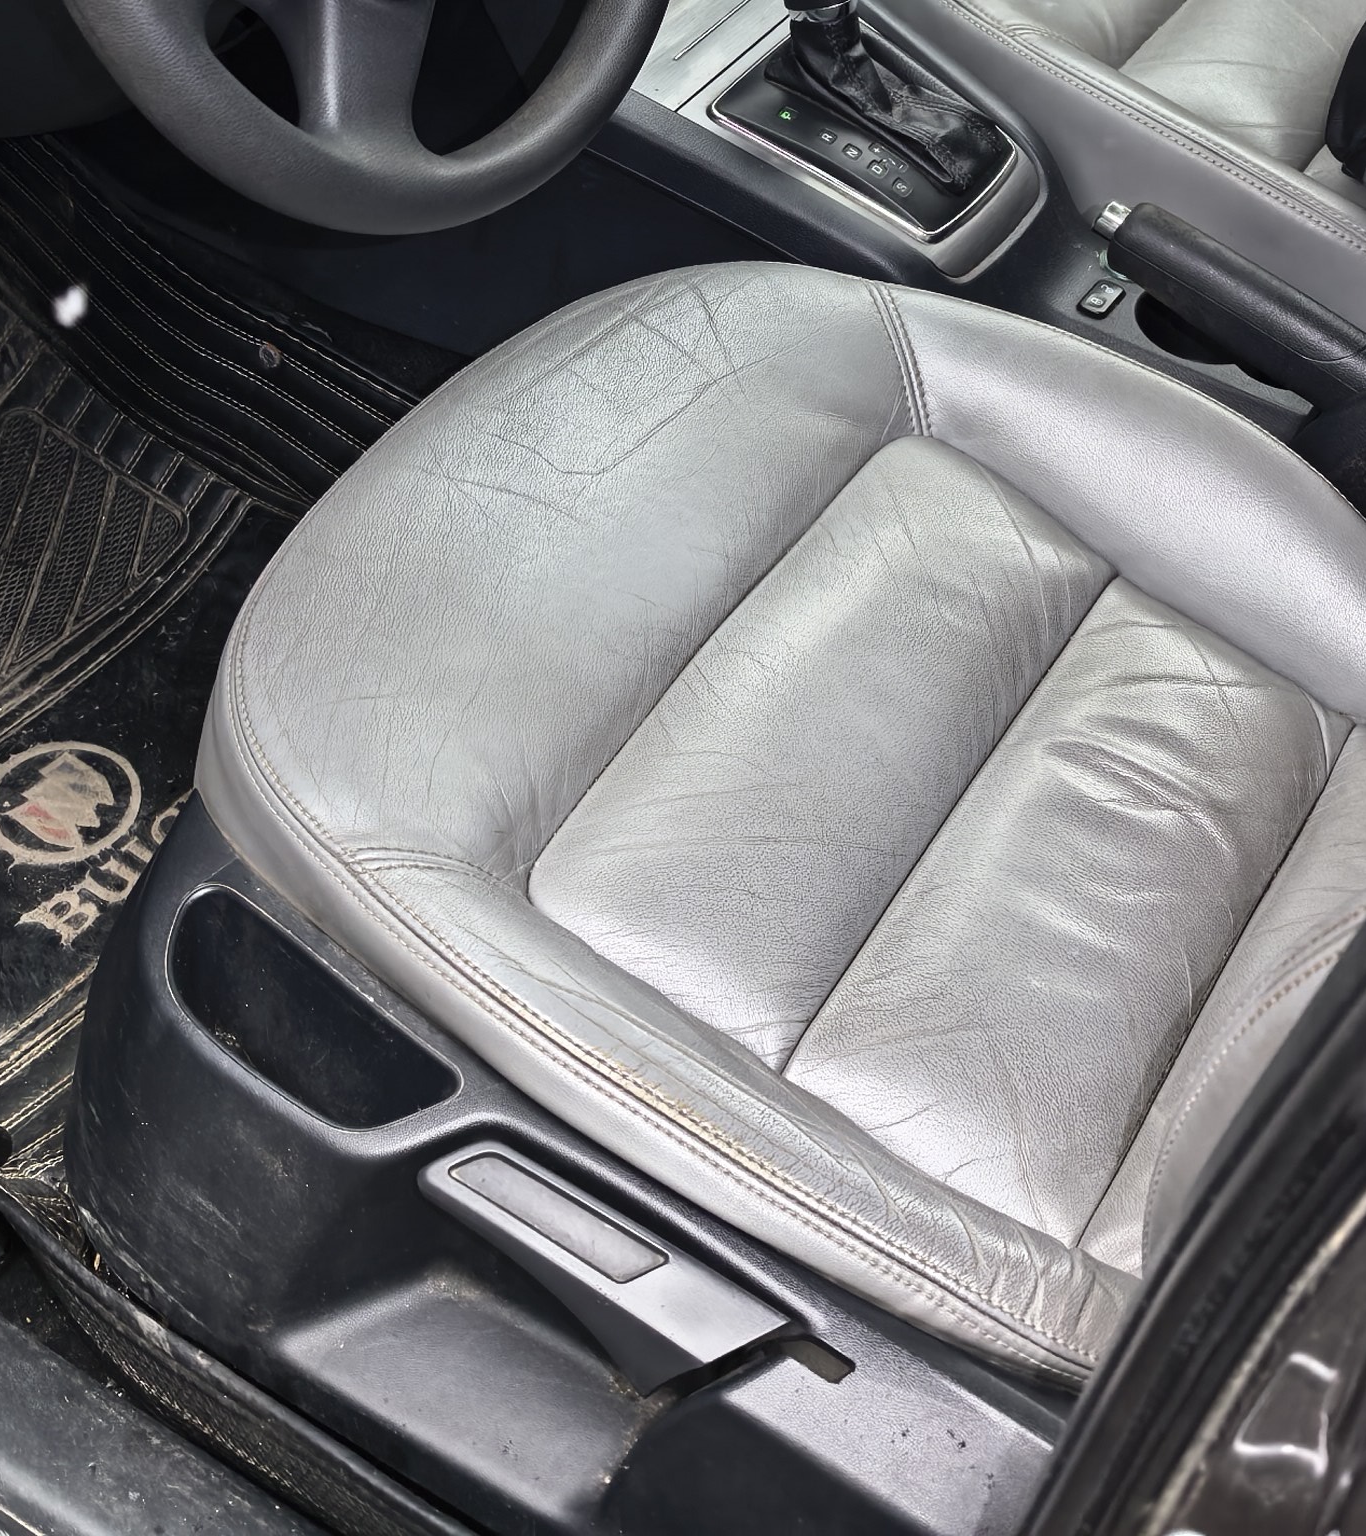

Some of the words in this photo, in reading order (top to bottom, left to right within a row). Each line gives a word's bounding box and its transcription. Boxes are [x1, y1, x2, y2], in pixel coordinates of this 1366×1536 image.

[821, 133, 833, 142] R
[846, 147, 859, 158] N
[871, 164, 883, 175] D
[896, 182, 908, 193] S
